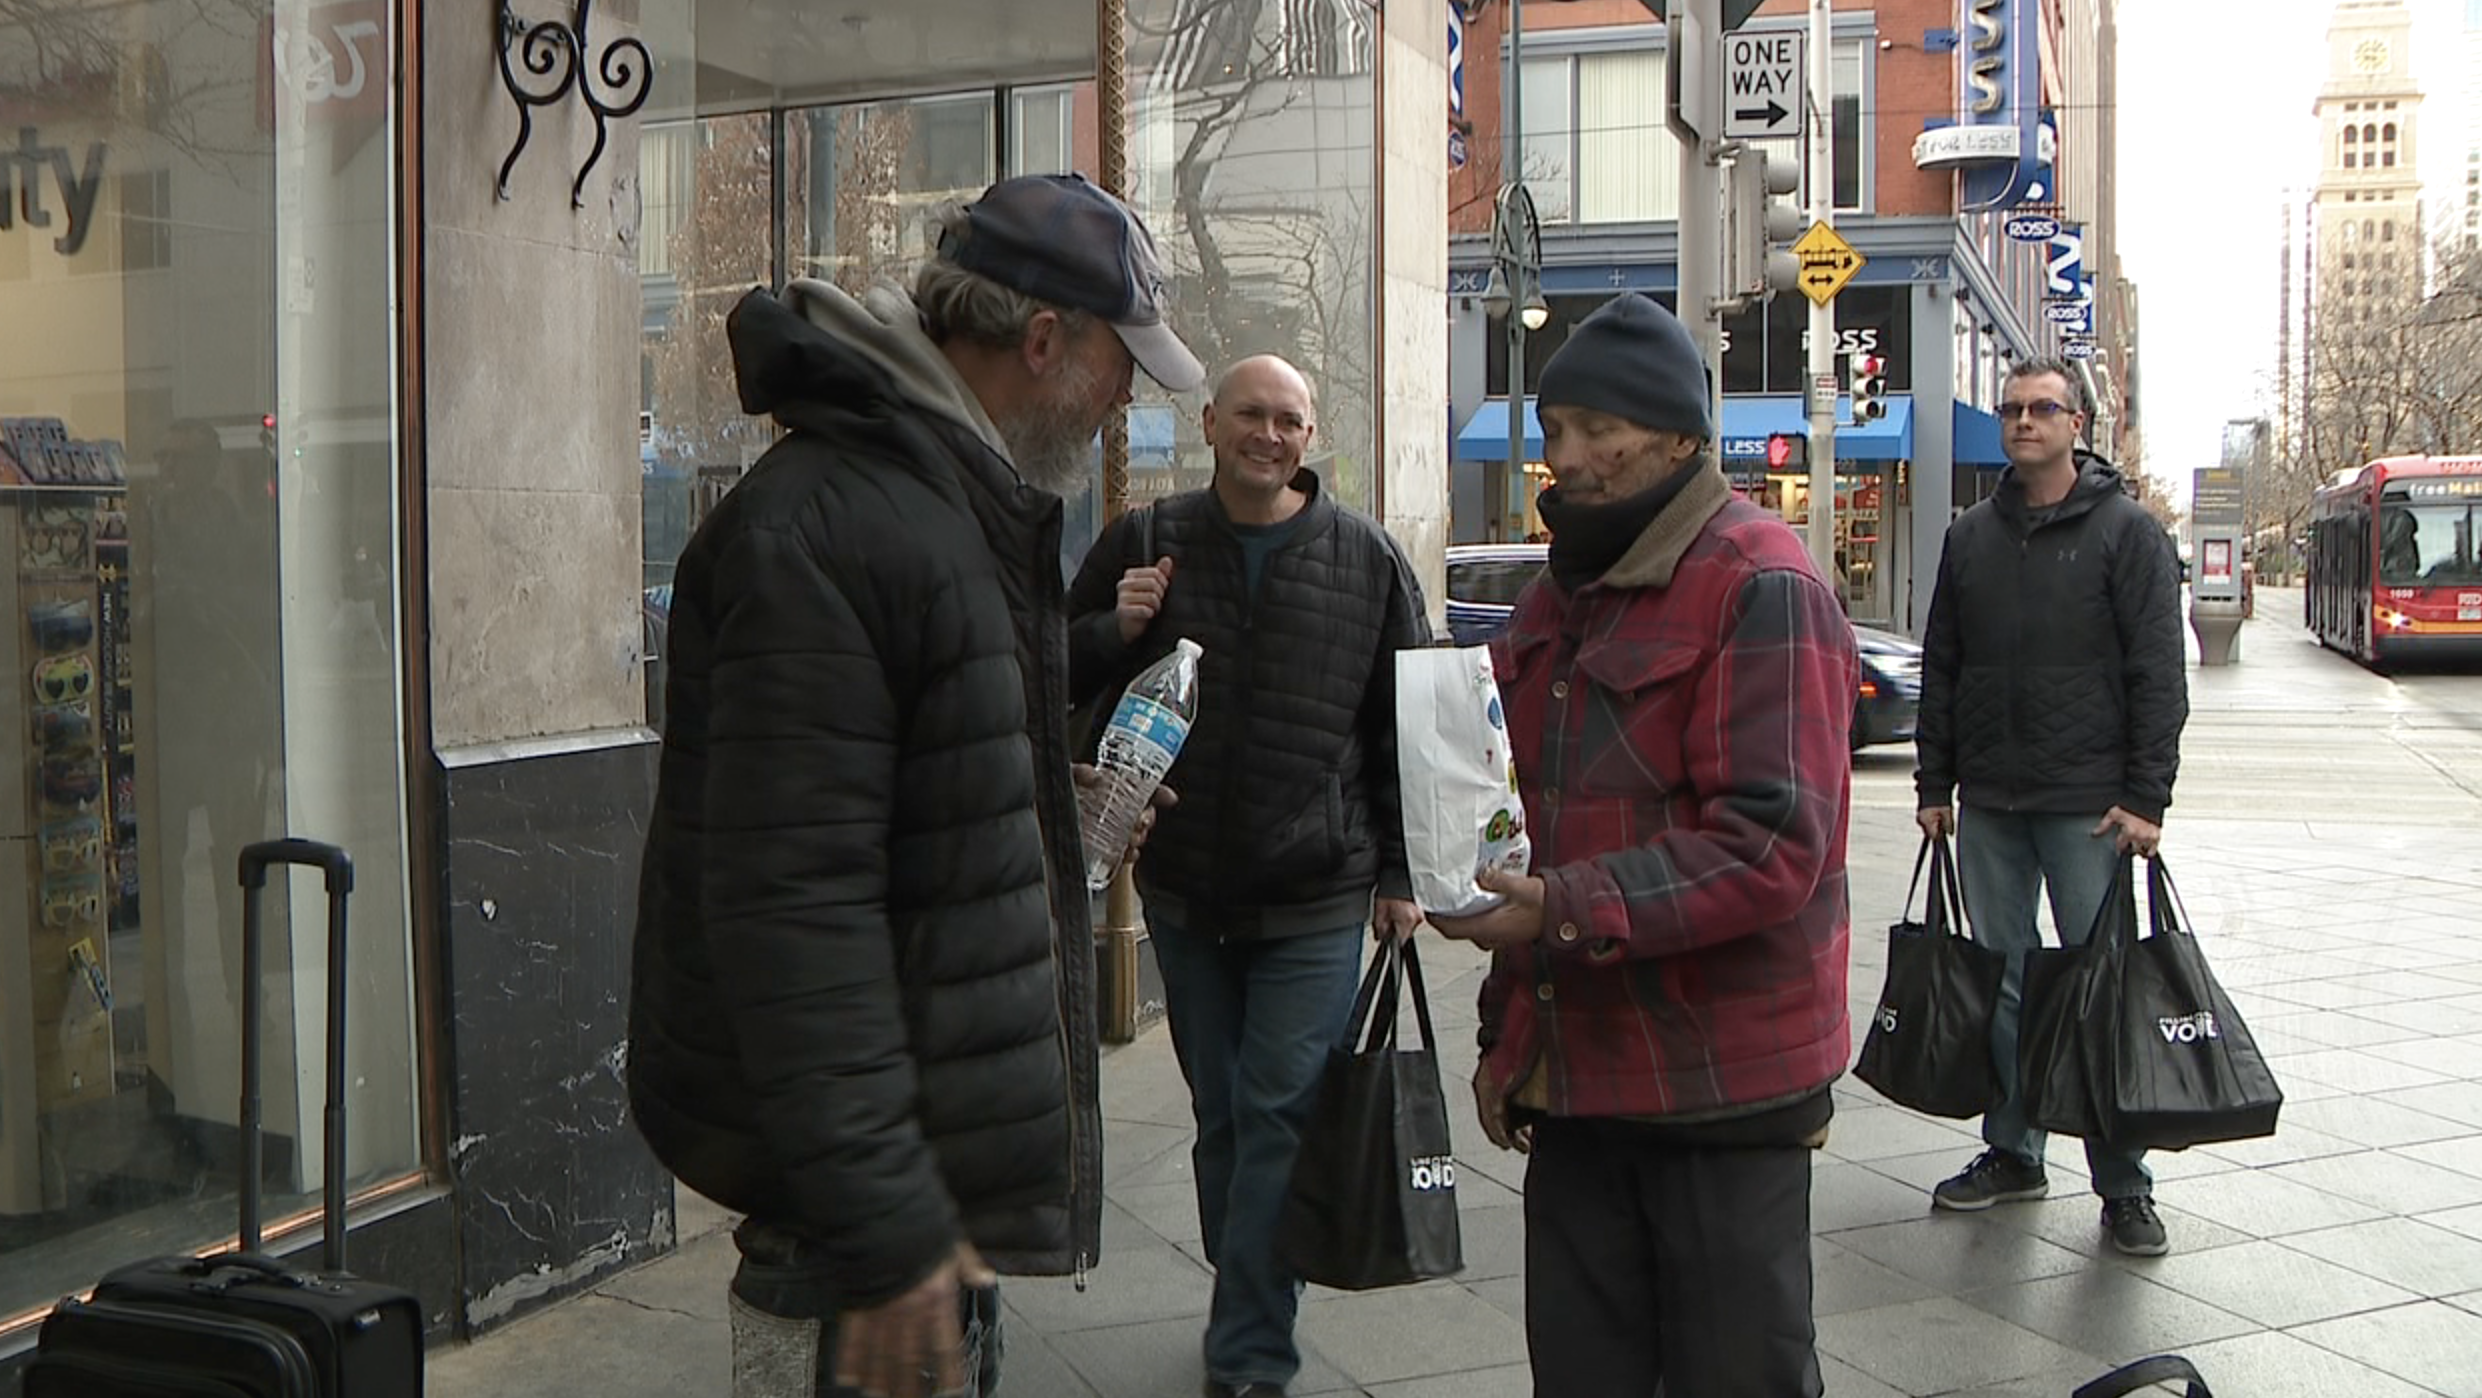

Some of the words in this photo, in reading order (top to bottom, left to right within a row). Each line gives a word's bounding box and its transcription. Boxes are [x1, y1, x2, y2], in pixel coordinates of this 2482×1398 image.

[1734, 38, 1792, 66] ONE
[1732, 67, 1793, 96] WAY
[2008, 221, 2056, 238] ROSS
[1725, 439, 1766, 455] LESS
